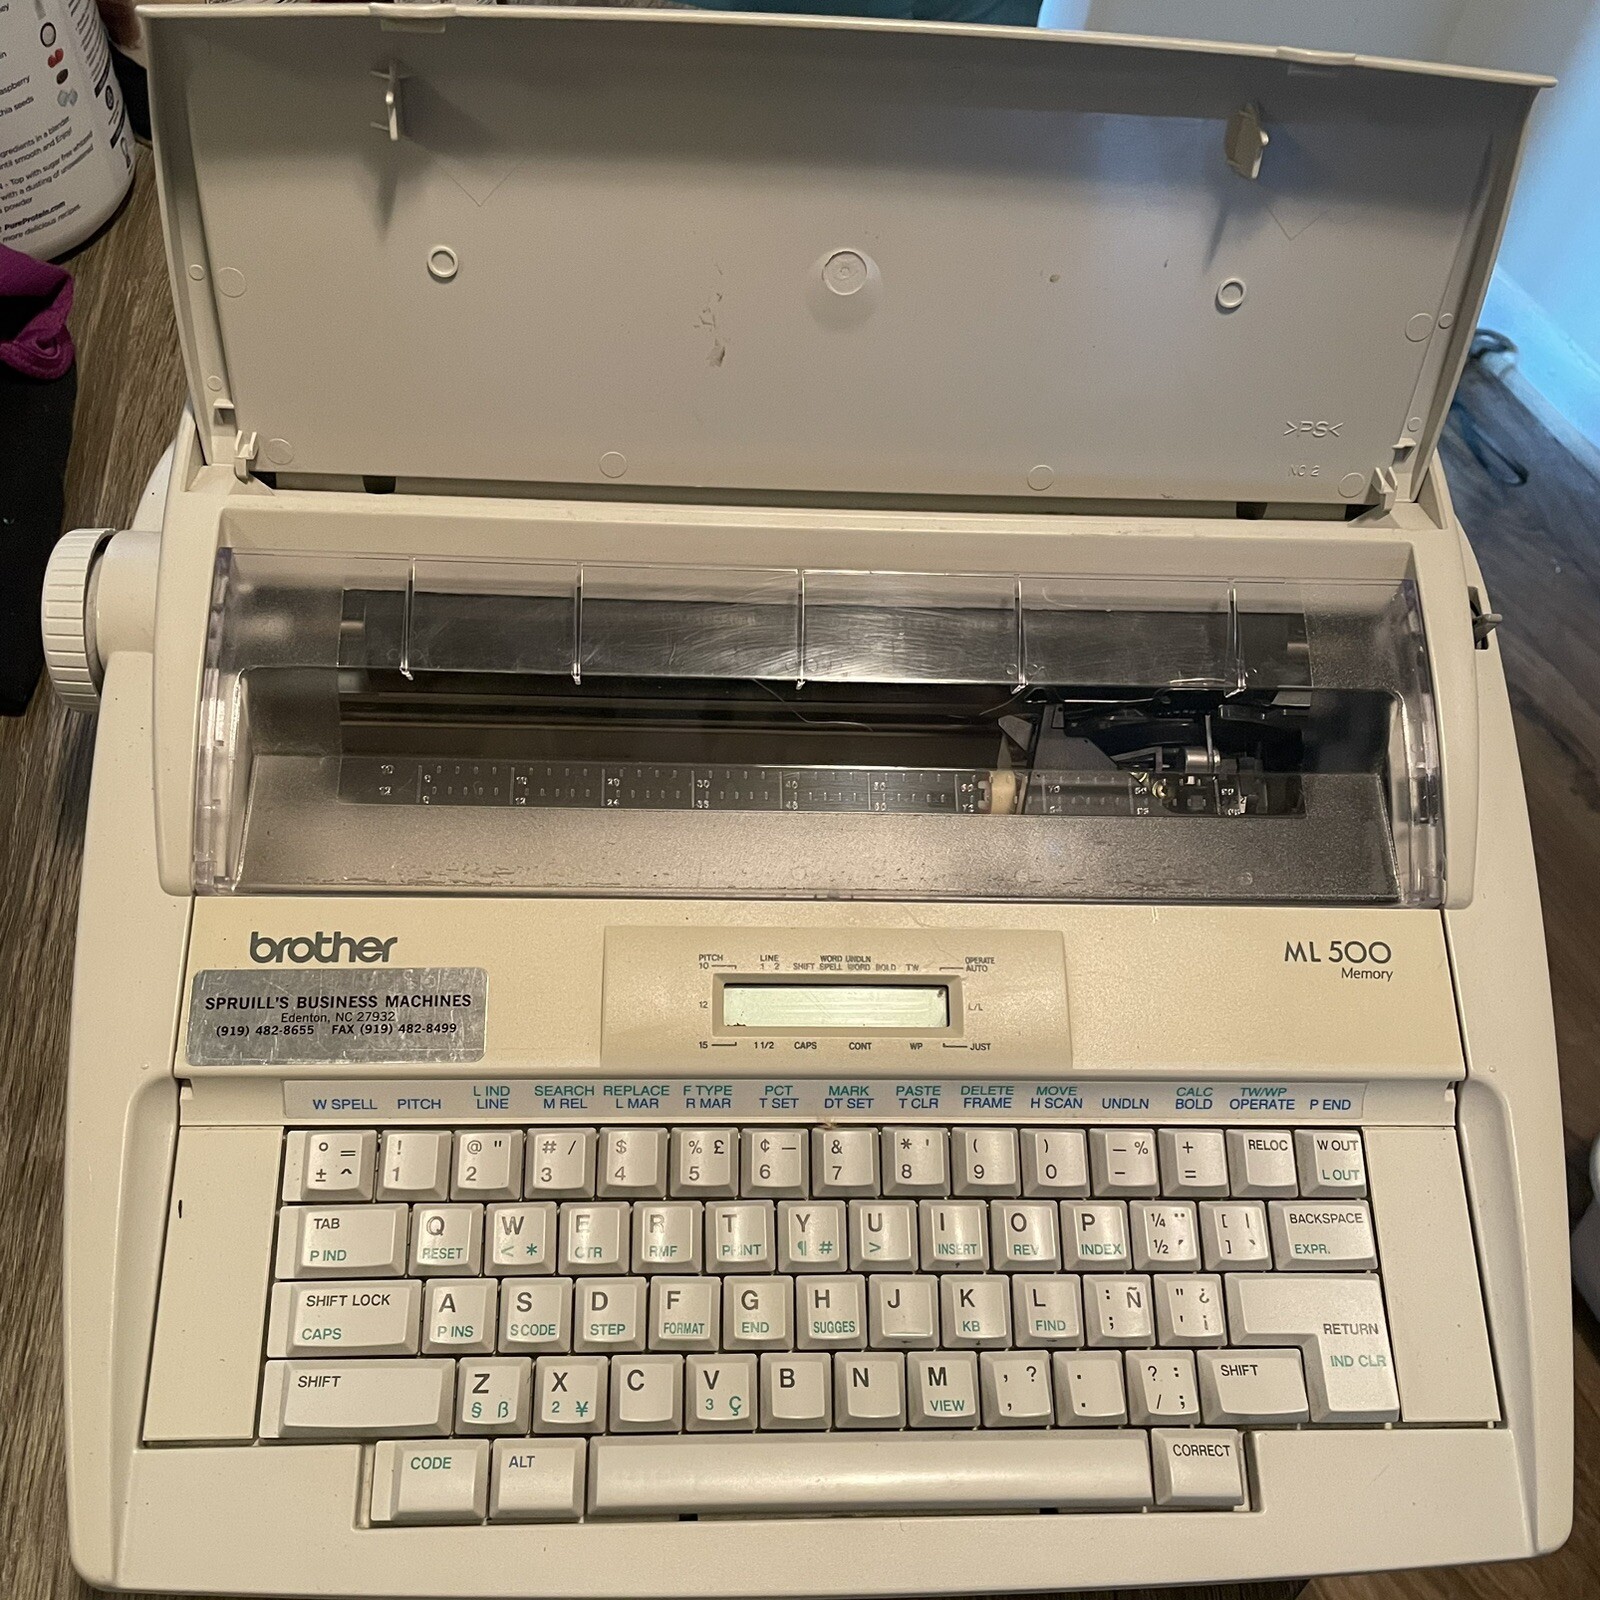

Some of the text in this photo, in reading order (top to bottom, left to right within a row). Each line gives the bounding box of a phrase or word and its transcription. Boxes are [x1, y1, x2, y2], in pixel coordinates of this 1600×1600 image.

[10, 177, 24, 185] Top
[26, 169, 42, 180] with
[4, 197, 32, 213] powder
[3, 232, 23, 242] more
[25, 218, 57, 235] delicious
[250, 931, 398, 963] brother
[1284, 941, 1392, 964] ML 500
[698, 954, 723, 962] PITCH
[760, 954, 779, 962] LINE
[965, 956, 995, 964] OPERATE
[793, 962, 815, 970] SHIFT
[966, 964, 988, 972] AUTO
[1341, 967, 1393, 982] Memory
[205, 994, 472, 1010] SPRUILL'S BUSINESS MACHINES
[281, 1011, 395, 1023] Edenton, NC 27932
[216, 1023, 457, 1038] (919) 482-8655 FAX (919) 482-8499
[794, 1042, 817, 1050] CAPS
[849, 1042, 872, 1050] CONT
[910, 1042, 923, 1050] WP
[970, 1042, 991, 1050] JUST
[473, 1086, 510, 1096] L IND
[534, 1086, 595, 1096] SEARCH
[604, 1086, 670, 1096] REPLACE
[683, 1086, 733, 1096] F TYPE
[764, 1086, 794, 1096] PCT
[828, 1086, 870, 1096] MARK
[896, 1086, 941, 1096] PASTE
[960, 1086, 1014, 1096] DELETE
[1036, 1086, 1078, 1096] MOVE
[1176, 1087, 1214, 1097] CALC
[1240, 1087, 1287, 1097] TW/WP
[312, 1098, 378, 1110] W SPELL
[397, 1098, 442, 1110] PITCH
[476, 1098, 509, 1110] LINE
[543, 1098, 588, 1109] M REL
[616, 1098, 660, 1109] L MAR
[686, 1098, 732, 1109] R MAR
[759, 1098, 799, 1109] T SET
[824, 1098, 874, 1109] DT SET
[900, 1098, 939, 1109] T CLR
[964, 1098, 1012, 1109] FRAME
[1030, 1098, 1083, 1109] H SCAN
[1102, 1098, 1150, 1109] UNDLN
[1176, 1098, 1213, 1110] BOLD
[1230, 1098, 1296, 1110] OPERATE
[1310, 1100, 1352, 1110] P END
[1248, 1140, 1288, 1151] RELOC
[1317, 1140, 1359, 1151] W OUT
[466, 1166, 477, 1182] 2
[1322, 1169, 1360, 1181] L OUT
[314, 1218, 340, 1230] TAB
[1082, 1213, 1096, 1231] P
[1289, 1213, 1364, 1224] BACKSPACE
[426, 1216, 445, 1236] Q
[502, 1216, 524, 1235] W
[422, 1248, 463, 1260] RESET
[938, 1244, 977, 1255] INSERT
[1014, 1244, 1039, 1255] REV
[1081, 1244, 1122, 1255] INDEX
[1295, 1244, 1331, 1255] EXPR.
[310, 1250, 347, 1262] P IND
[306, 1294, 390, 1307] SHIFT LOCK
[1126, 1286, 1142, 1308] Ñ
[438, 1294, 456, 1313] A
[590, 1324, 626, 1336] STEP
[663, 1322, 705, 1334] FORMAT
[742, 1322, 770, 1333] END
[813, 1321, 855, 1334] SUGGES
[962, 1321, 980, 1332] KB
[1036, 1320, 1066, 1331] FIND
[1322, 1323, 1379, 1335] RETURN
[302, 1328, 342, 1340] CAPS
[437, 1326, 474, 1338] P INS
[1330, 1354, 1386, 1367] IND CLR
[928, 1366, 948, 1386] M
[1221, 1364, 1258, 1377] SHIFT
[298, 1376, 341, 1388] SHIFT
[930, 1400, 965, 1412] VIEW
[1172, 1444, 1230, 1458] CORRECT
[410, 1456, 452, 1470] CODE
[508, 1455, 536, 1468] ALT
